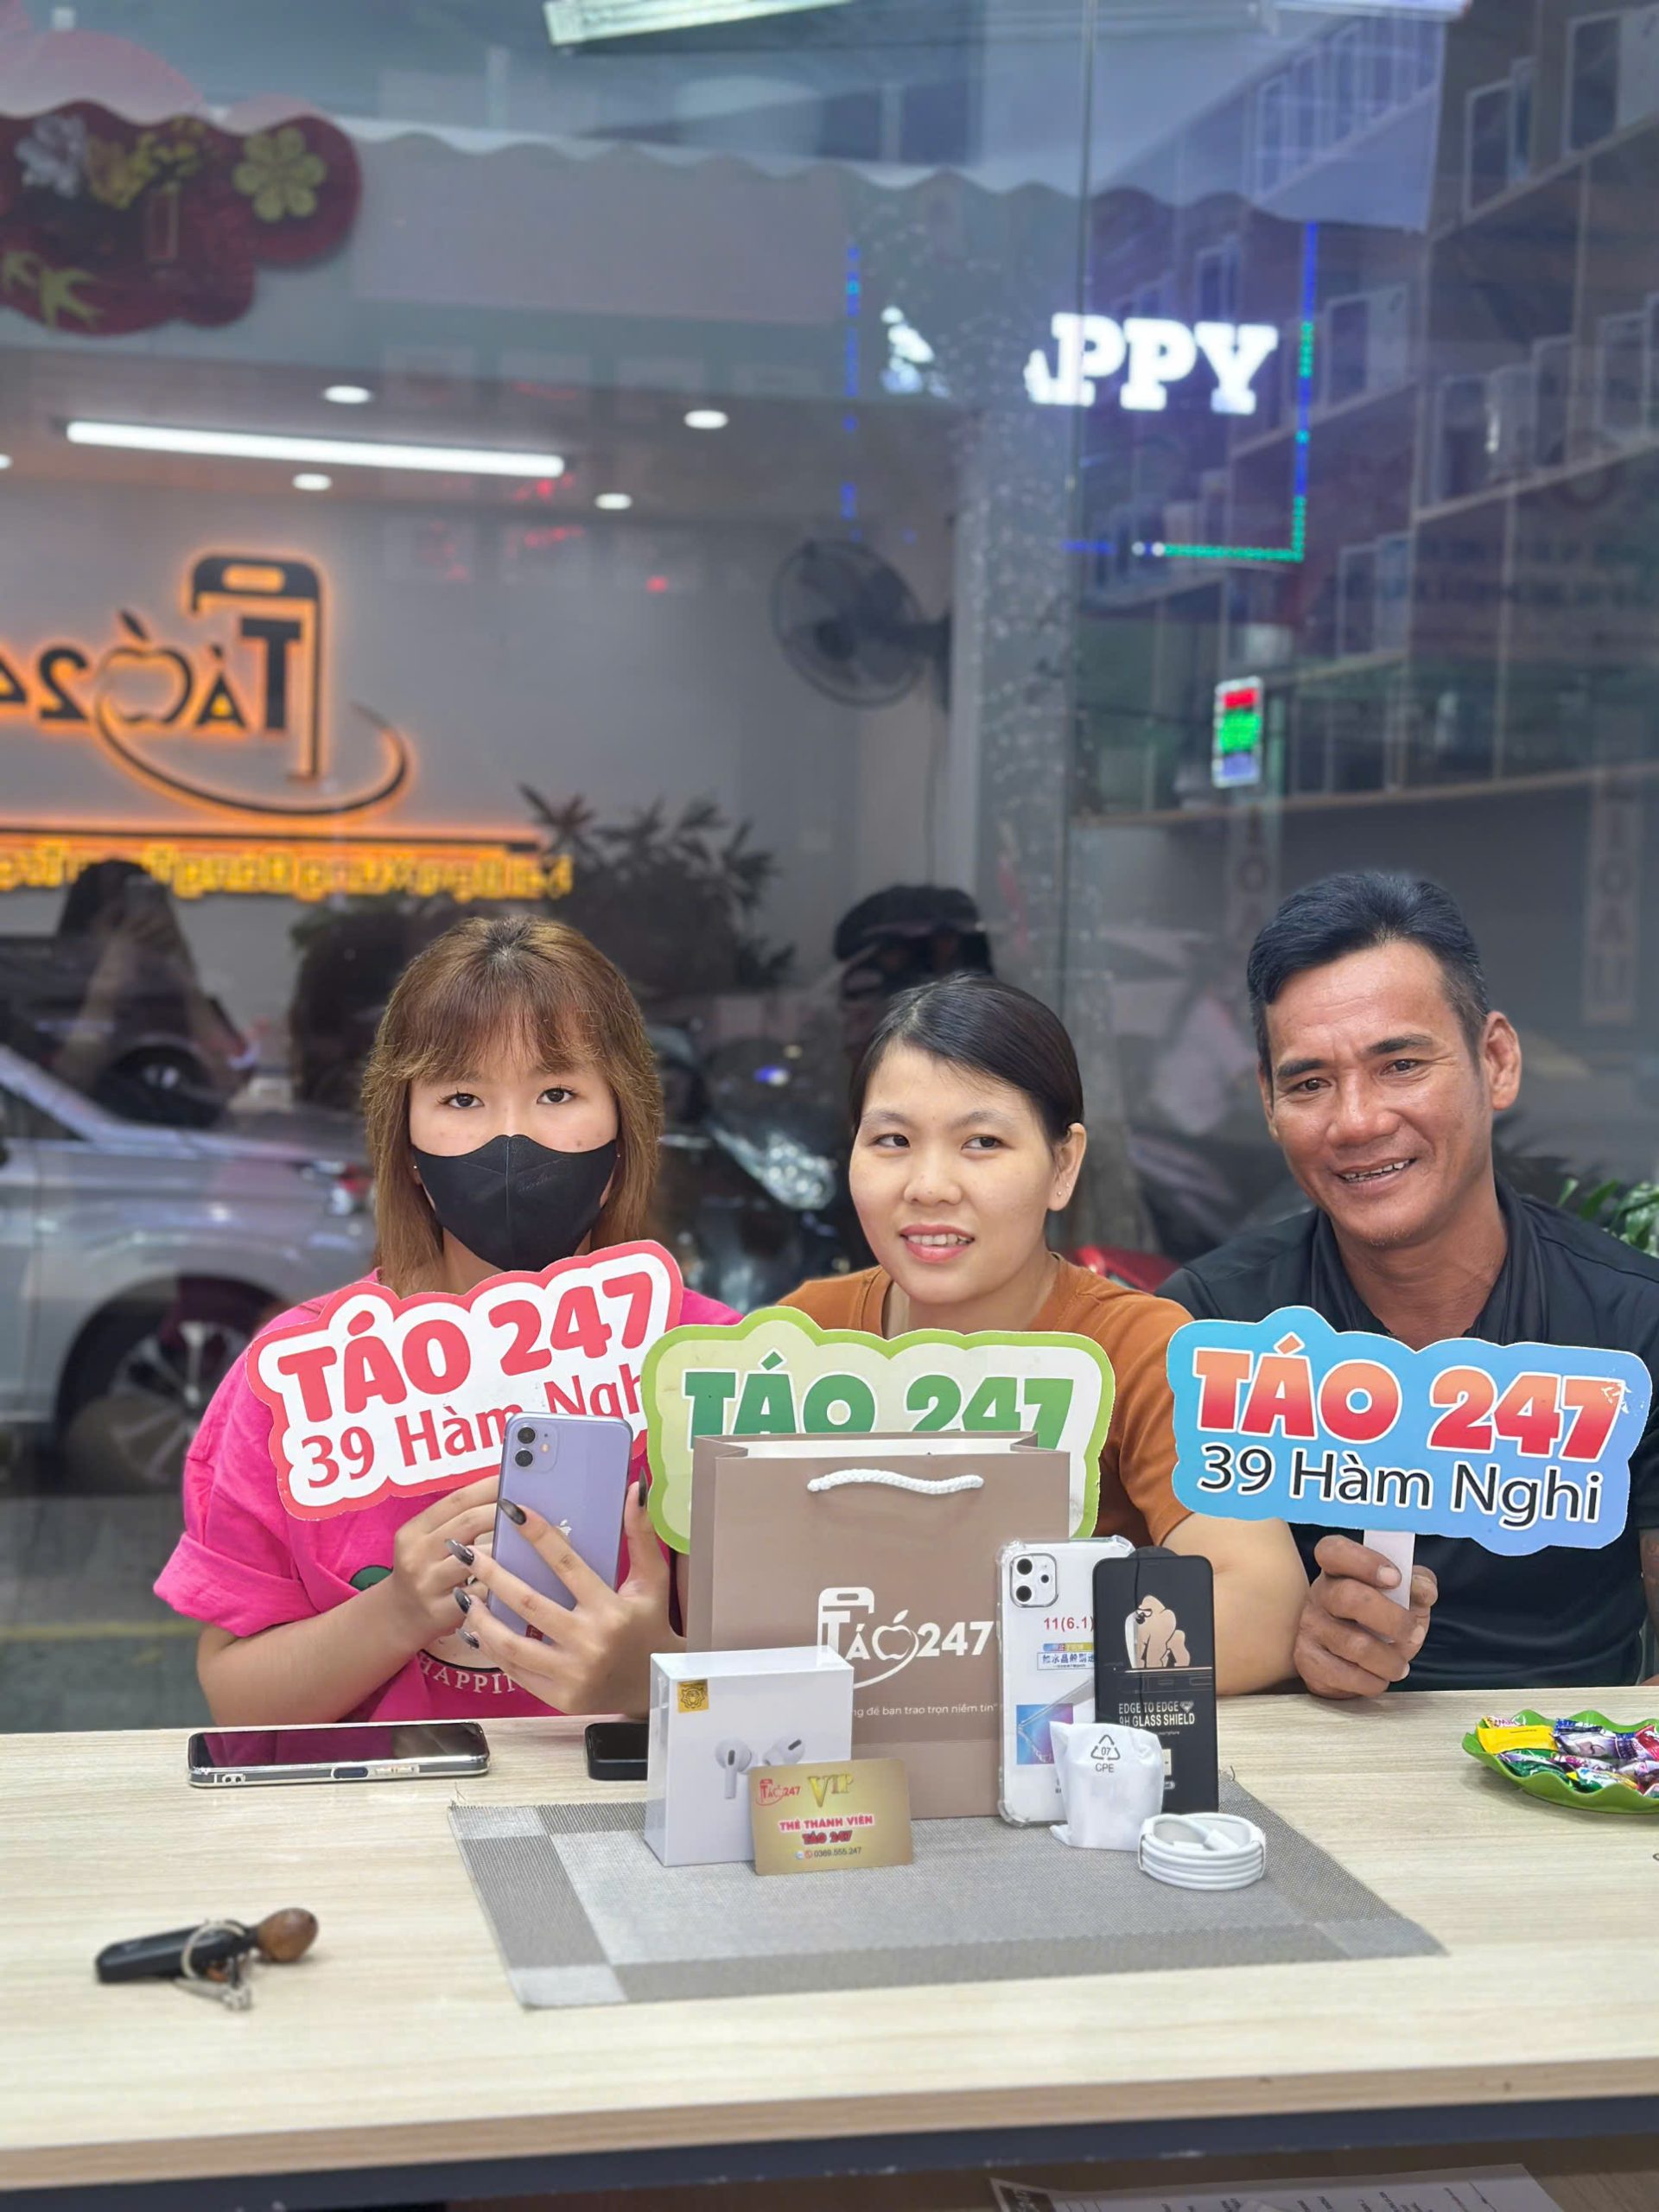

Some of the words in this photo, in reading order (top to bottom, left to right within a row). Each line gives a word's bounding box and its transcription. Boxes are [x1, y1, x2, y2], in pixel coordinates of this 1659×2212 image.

[278, 1310, 471, 1422] TÁO
[488, 1271, 653, 1376] 247
[685, 1351, 875, 1436] TÁO
[906, 1374, 1074, 1450] 247
[1193, 1333, 1402, 1444] TÁO
[1427, 1365, 1624, 1462] 247
[302, 1427, 375, 1488] 39
[394, 1404, 524, 1467] Hàm
[1198, 1445, 1274, 1493] 39
[1290, 1449, 1432, 1508] Hàm
[1451, 1461, 1603, 1528] Nghi
[905, 1706, 925, 1715] trao
[1118, 1703, 1141, 1714] EDGE
[1143, 1702, 1154, 1713] TO
[1156, 1700, 1179, 1713] EDGE
[1132, 1713, 1161, 1726] GLASS
[1164, 1713, 1195, 1726] SHIELD
[1095, 1763, 1115, 1773] CPE
[1101, 1746, 1111, 1756] 07
[807, 1774, 854, 1808] VIP
